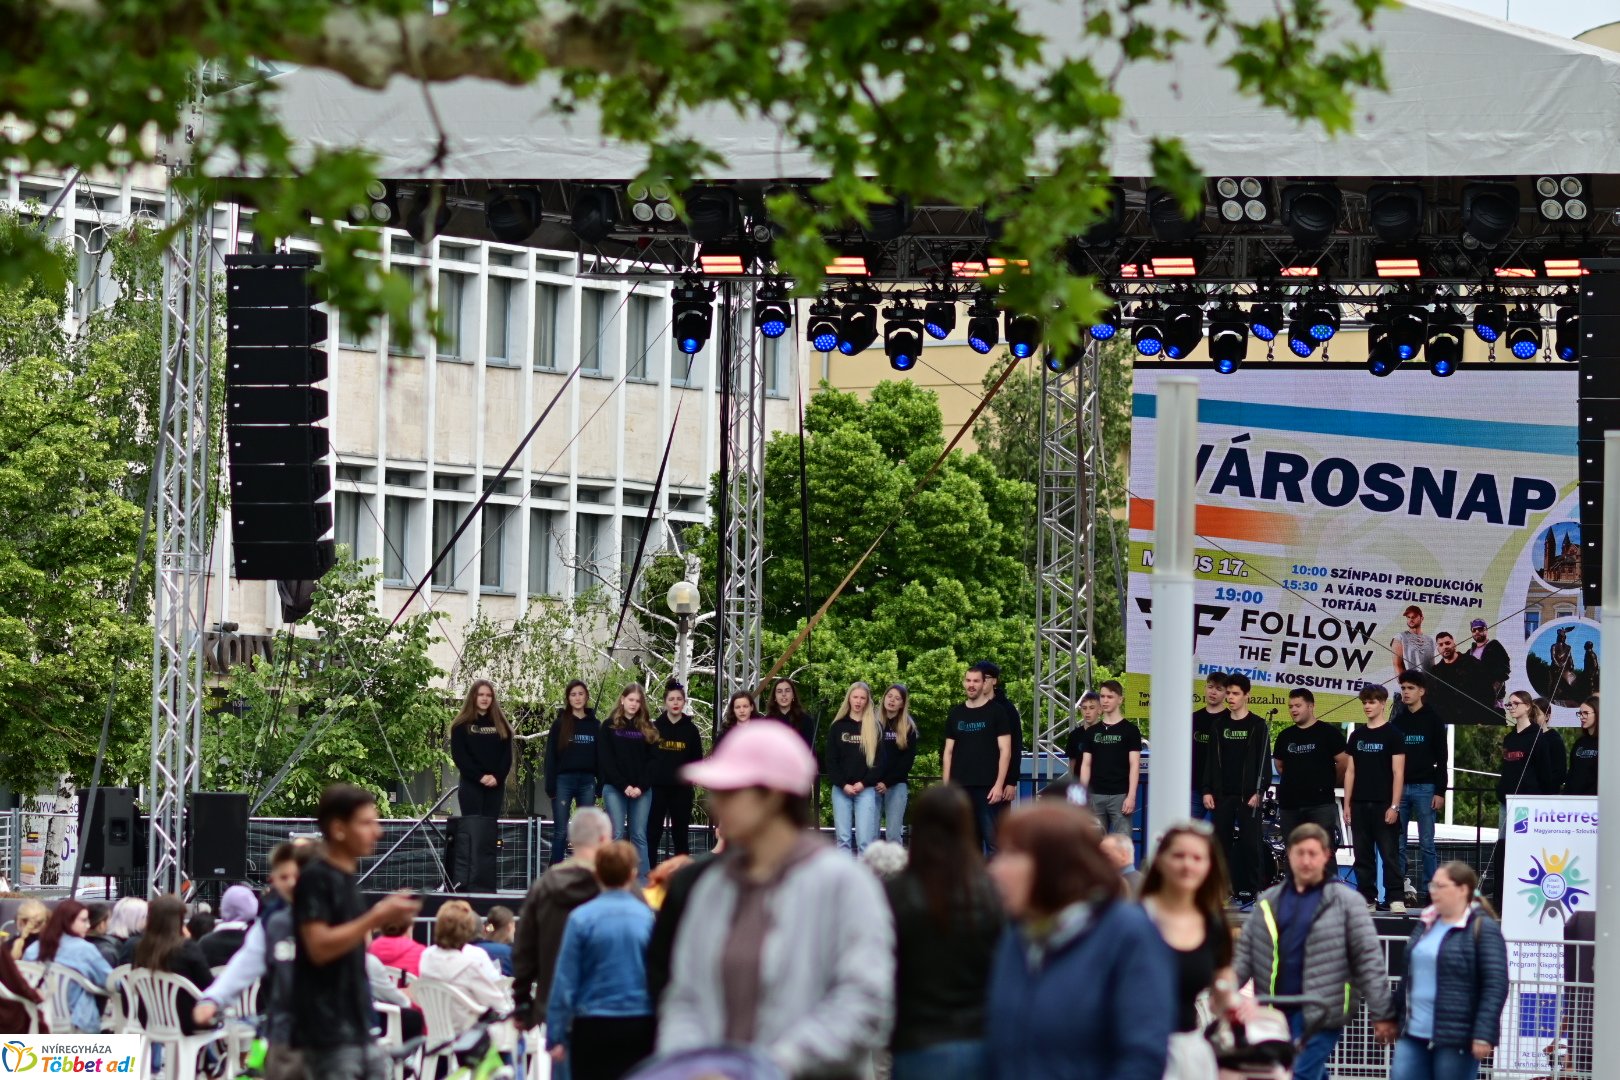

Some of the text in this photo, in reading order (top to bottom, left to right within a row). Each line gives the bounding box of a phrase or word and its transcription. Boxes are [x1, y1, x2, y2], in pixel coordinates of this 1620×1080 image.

[1217, 558, 1249, 577] 17.
[1291, 564, 1484, 593] 10:00 SZÍNPADI PRODUKCIÓK
[1214, 587, 1263, 604] 19:00
[1281, 579, 1483, 609] 15:30 A VÁROS SZÜLETÉSNAPI
[1321, 598, 1377, 613] TORTÁJA
[1240, 608, 1377, 645] FOLLOW
[1238, 641, 1373, 673] THE FLOW
[1275, 671, 1342, 690] KOSSUTH
[1534, 809, 1599, 826] Interreg
